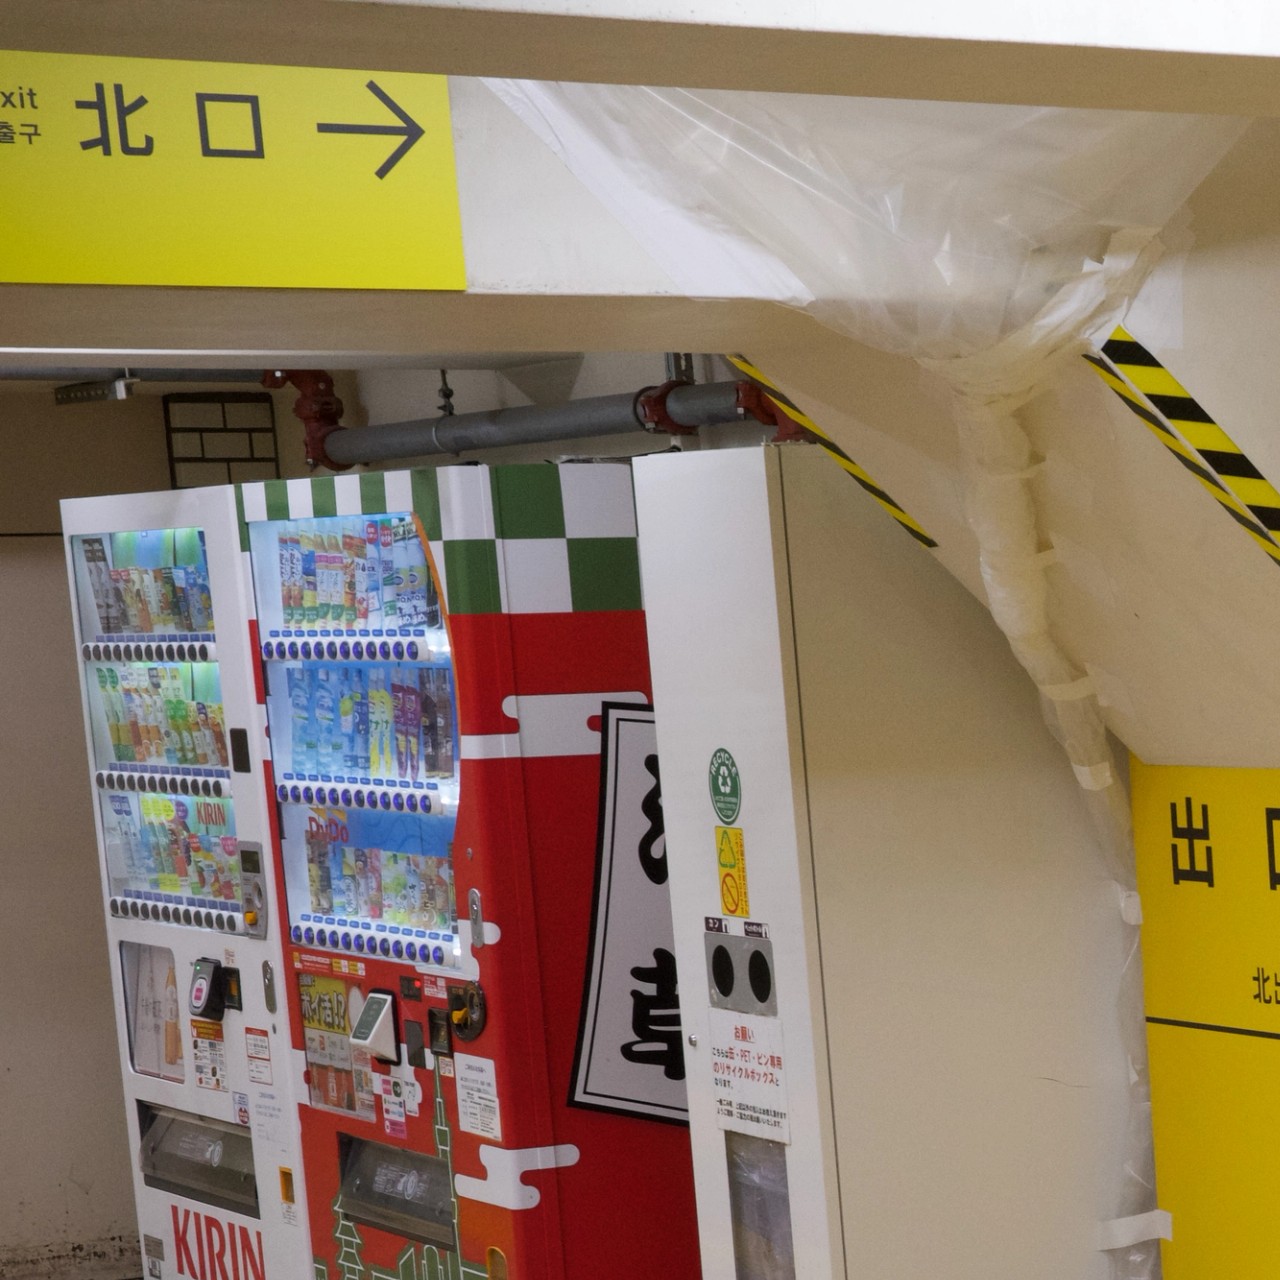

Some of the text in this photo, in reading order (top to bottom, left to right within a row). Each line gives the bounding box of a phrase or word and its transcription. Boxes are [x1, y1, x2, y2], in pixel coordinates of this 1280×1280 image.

[0, 86, 38, 109] xit
[710, 751, 738, 777] RECYCLE
[196, 801, 226, 827] KIRIN
[734, 1025, 755, 1040] お願い
